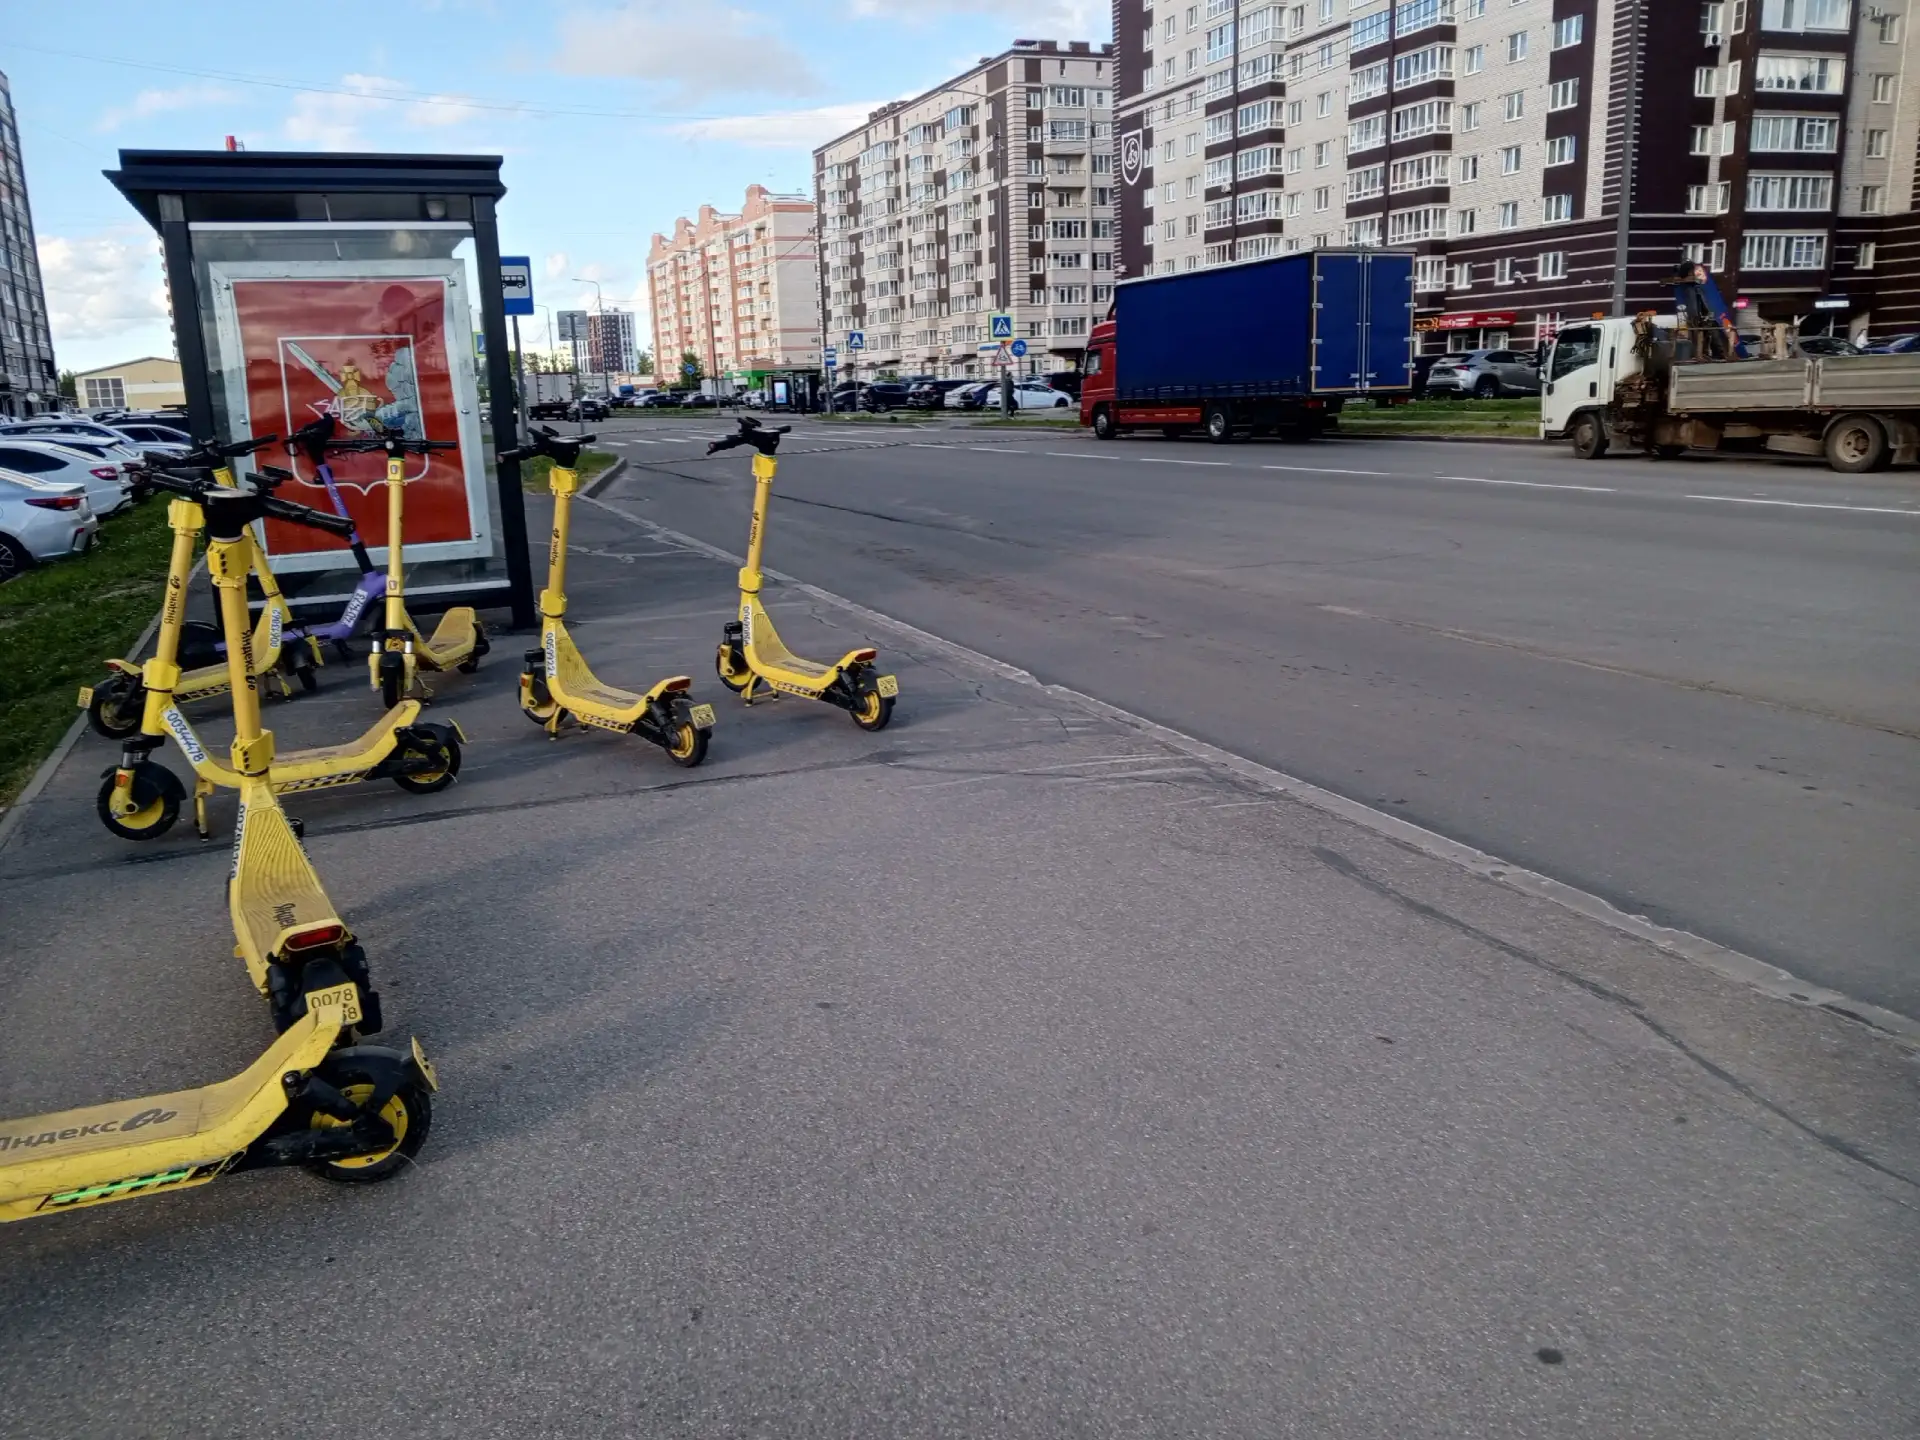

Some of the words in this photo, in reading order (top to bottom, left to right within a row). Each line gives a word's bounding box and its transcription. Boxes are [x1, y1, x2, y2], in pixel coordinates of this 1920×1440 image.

[163, 591, 179, 625] Яндекс
[240, 629, 254, 673] Яндекс
[310, 988, 354, 1009] 0078
